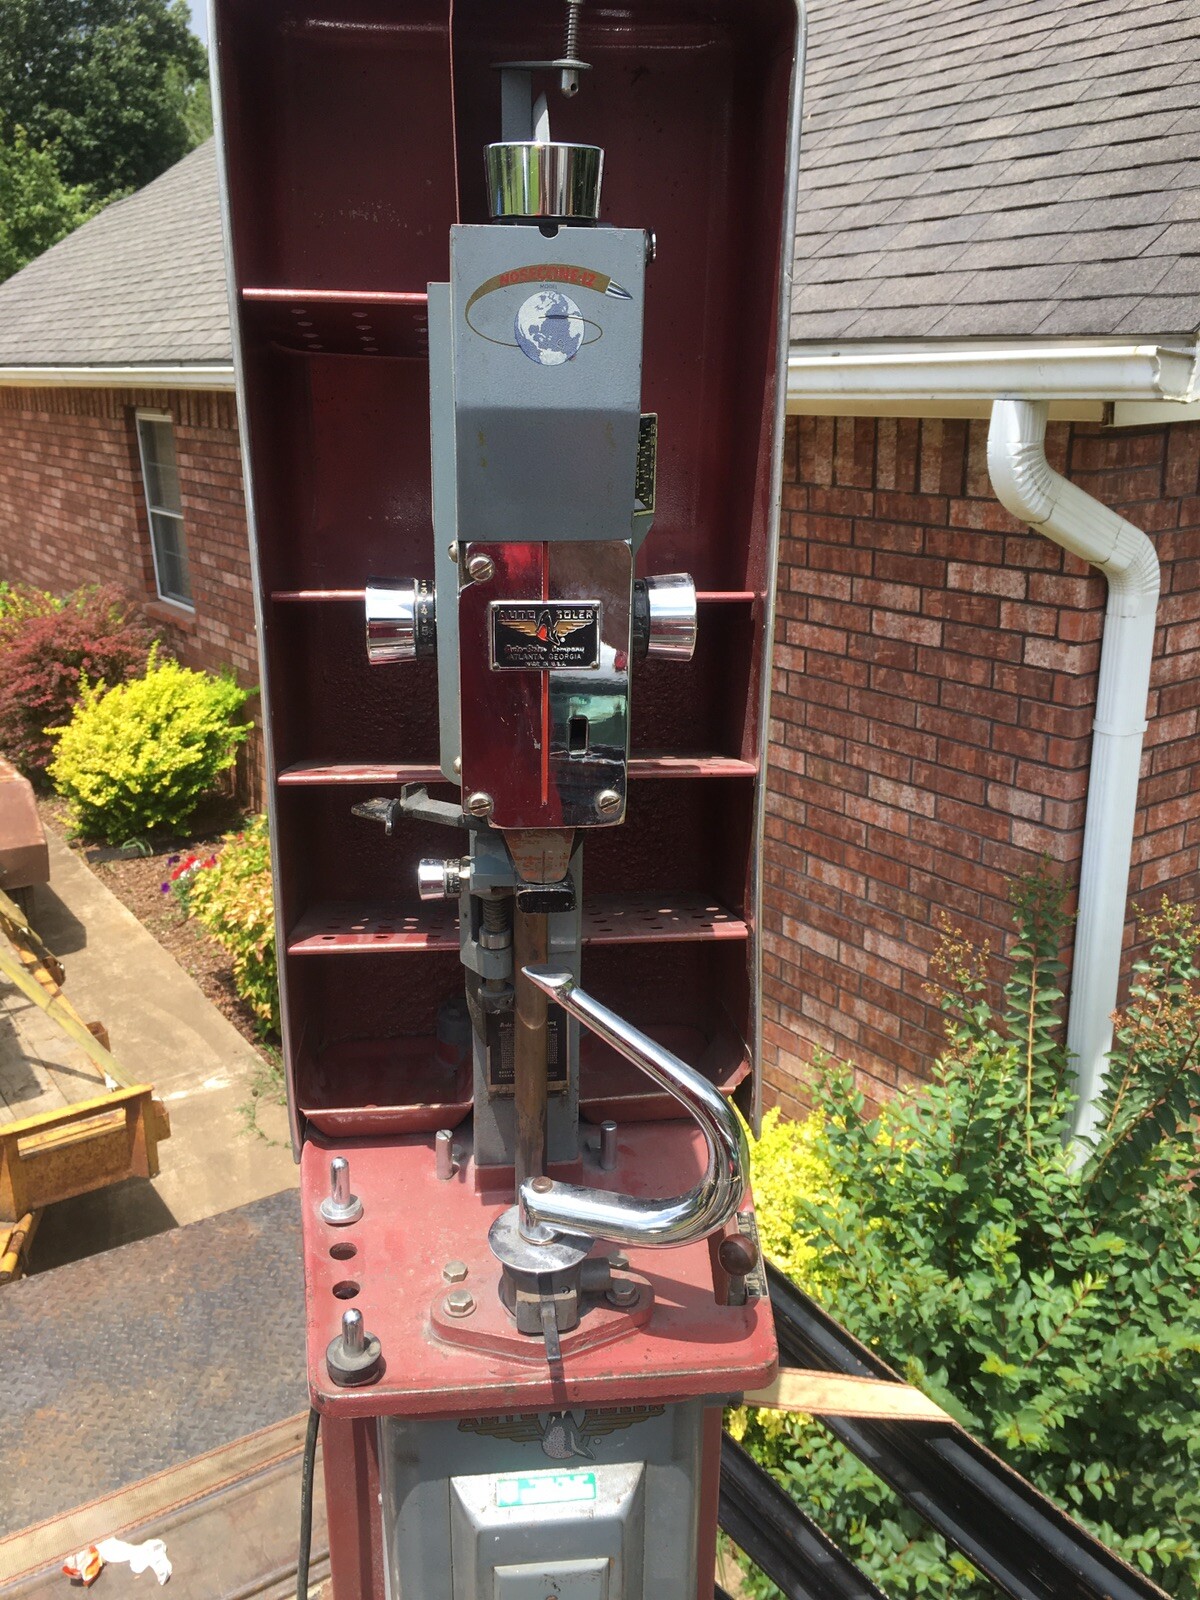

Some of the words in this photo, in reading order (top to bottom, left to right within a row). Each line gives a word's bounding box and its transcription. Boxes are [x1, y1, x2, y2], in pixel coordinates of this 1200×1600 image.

[499, 610, 536, 619] AUTO
[556, 610, 593, 619] SOLER
[551, 645, 585, 653] Company
[548, 653, 582, 661] GEORGIA
